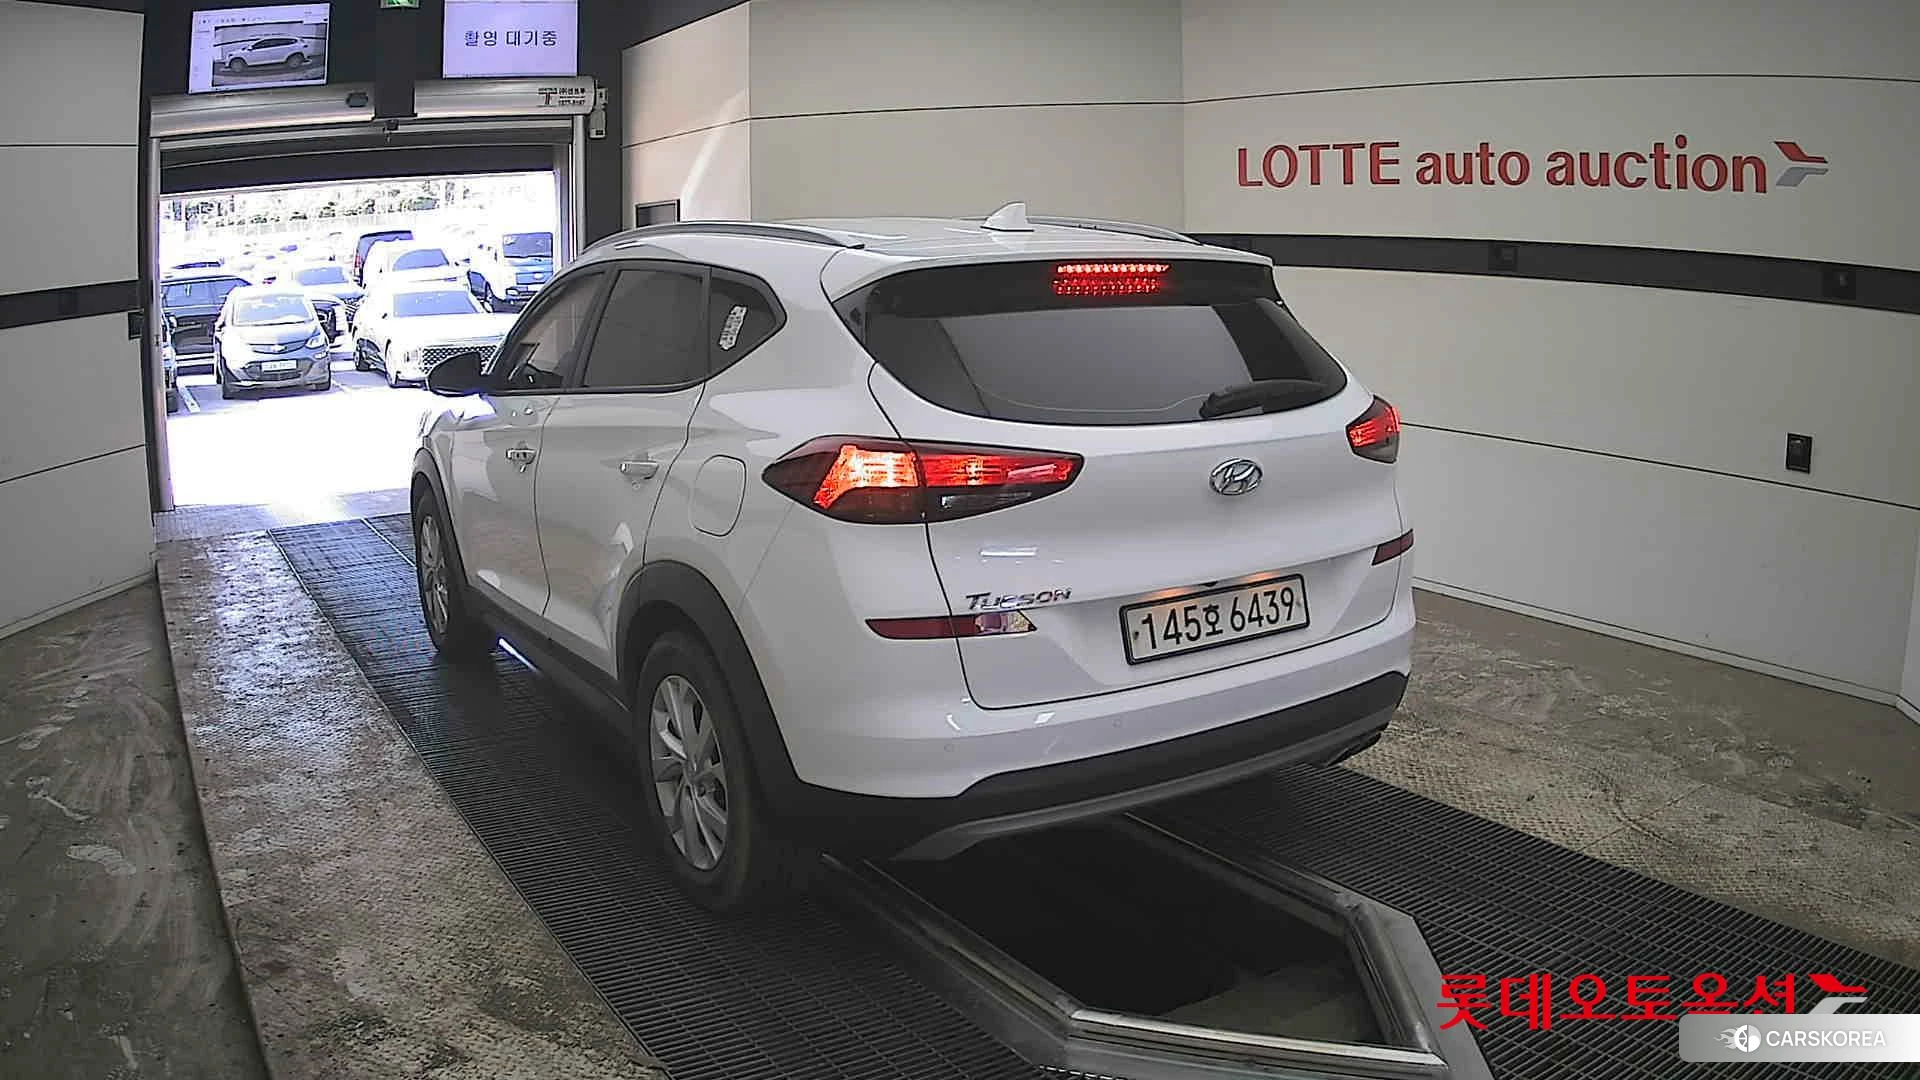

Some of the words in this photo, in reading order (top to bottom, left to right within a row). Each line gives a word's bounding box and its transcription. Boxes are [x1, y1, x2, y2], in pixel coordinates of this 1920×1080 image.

[505, 30, 558, 47] 대기중
[1237, 141, 1400, 188] LOTTE
[1415, 142, 1531, 186] auto
[1545, 134, 1768, 194] auction
[1141, 603, 1224, 649] 145호
[1230, 586, 1295, 632] 6439
